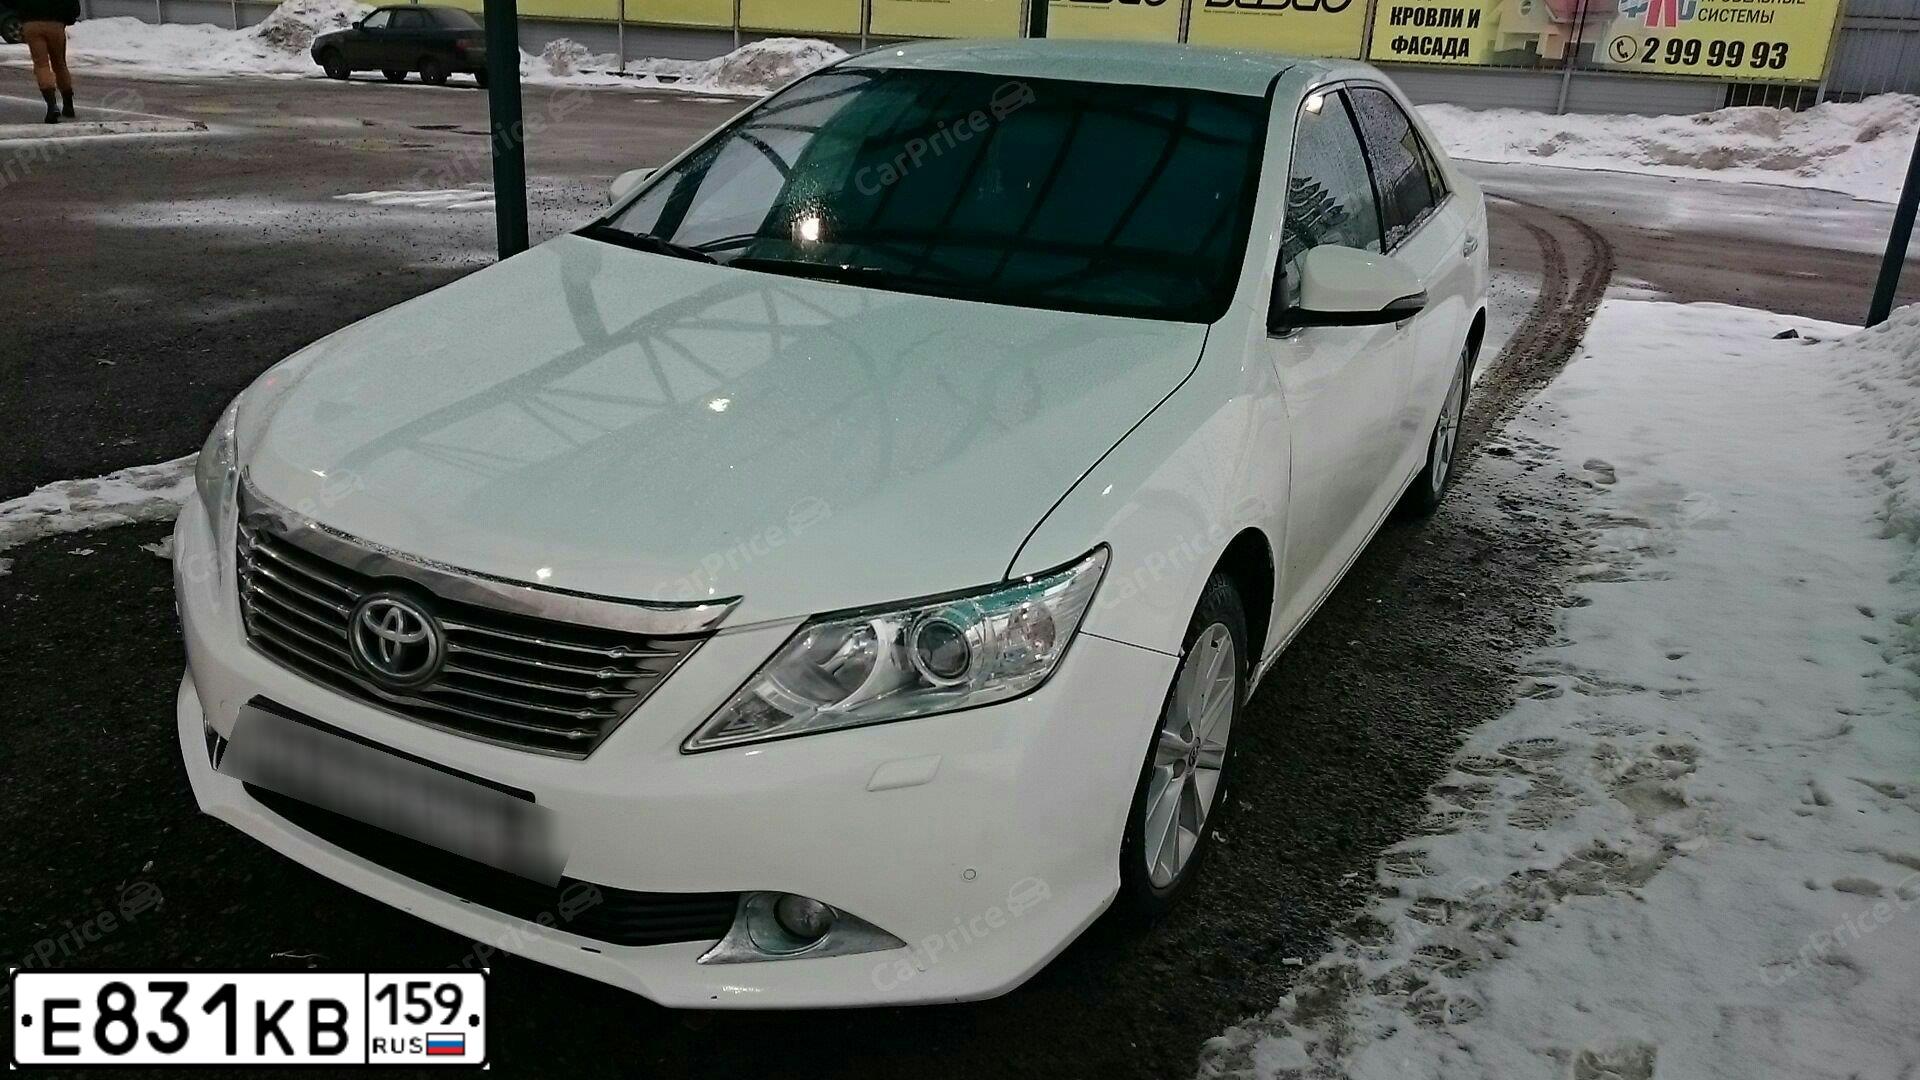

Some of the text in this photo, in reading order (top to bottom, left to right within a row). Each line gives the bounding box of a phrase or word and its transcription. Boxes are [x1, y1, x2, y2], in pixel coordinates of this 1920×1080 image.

[1390, 7, 1481, 29] КРОВЛИ И
[1698, 8, 1774, 23] СИСТЕМЫ
[1391, 35, 1470, 59] ФАСАДА
[1641, 37, 1789, 69] 2 99 99 93
